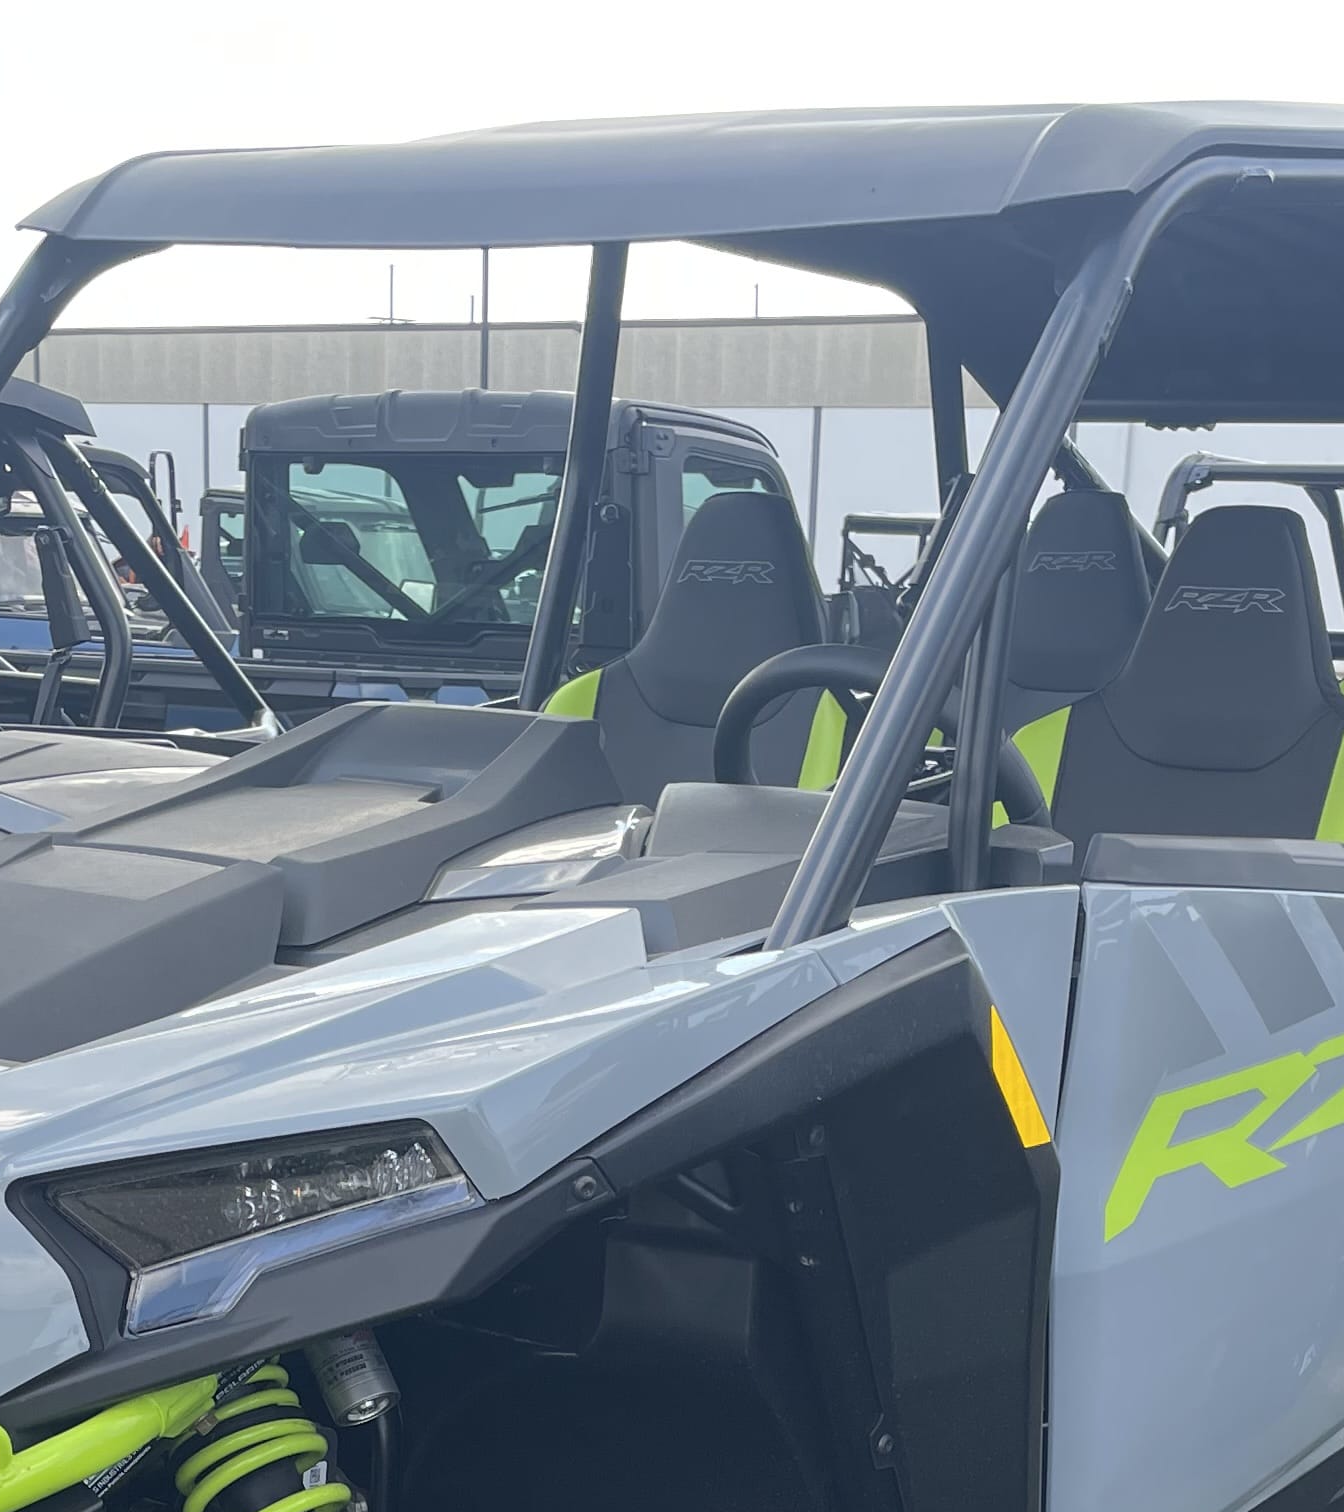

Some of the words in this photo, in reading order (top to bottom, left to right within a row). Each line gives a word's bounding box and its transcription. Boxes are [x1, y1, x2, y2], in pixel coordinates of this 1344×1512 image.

[677, 559, 775, 585] RZR
[1027, 550, 1117, 574] RZR
[1164, 585, 1285, 614] RZR
